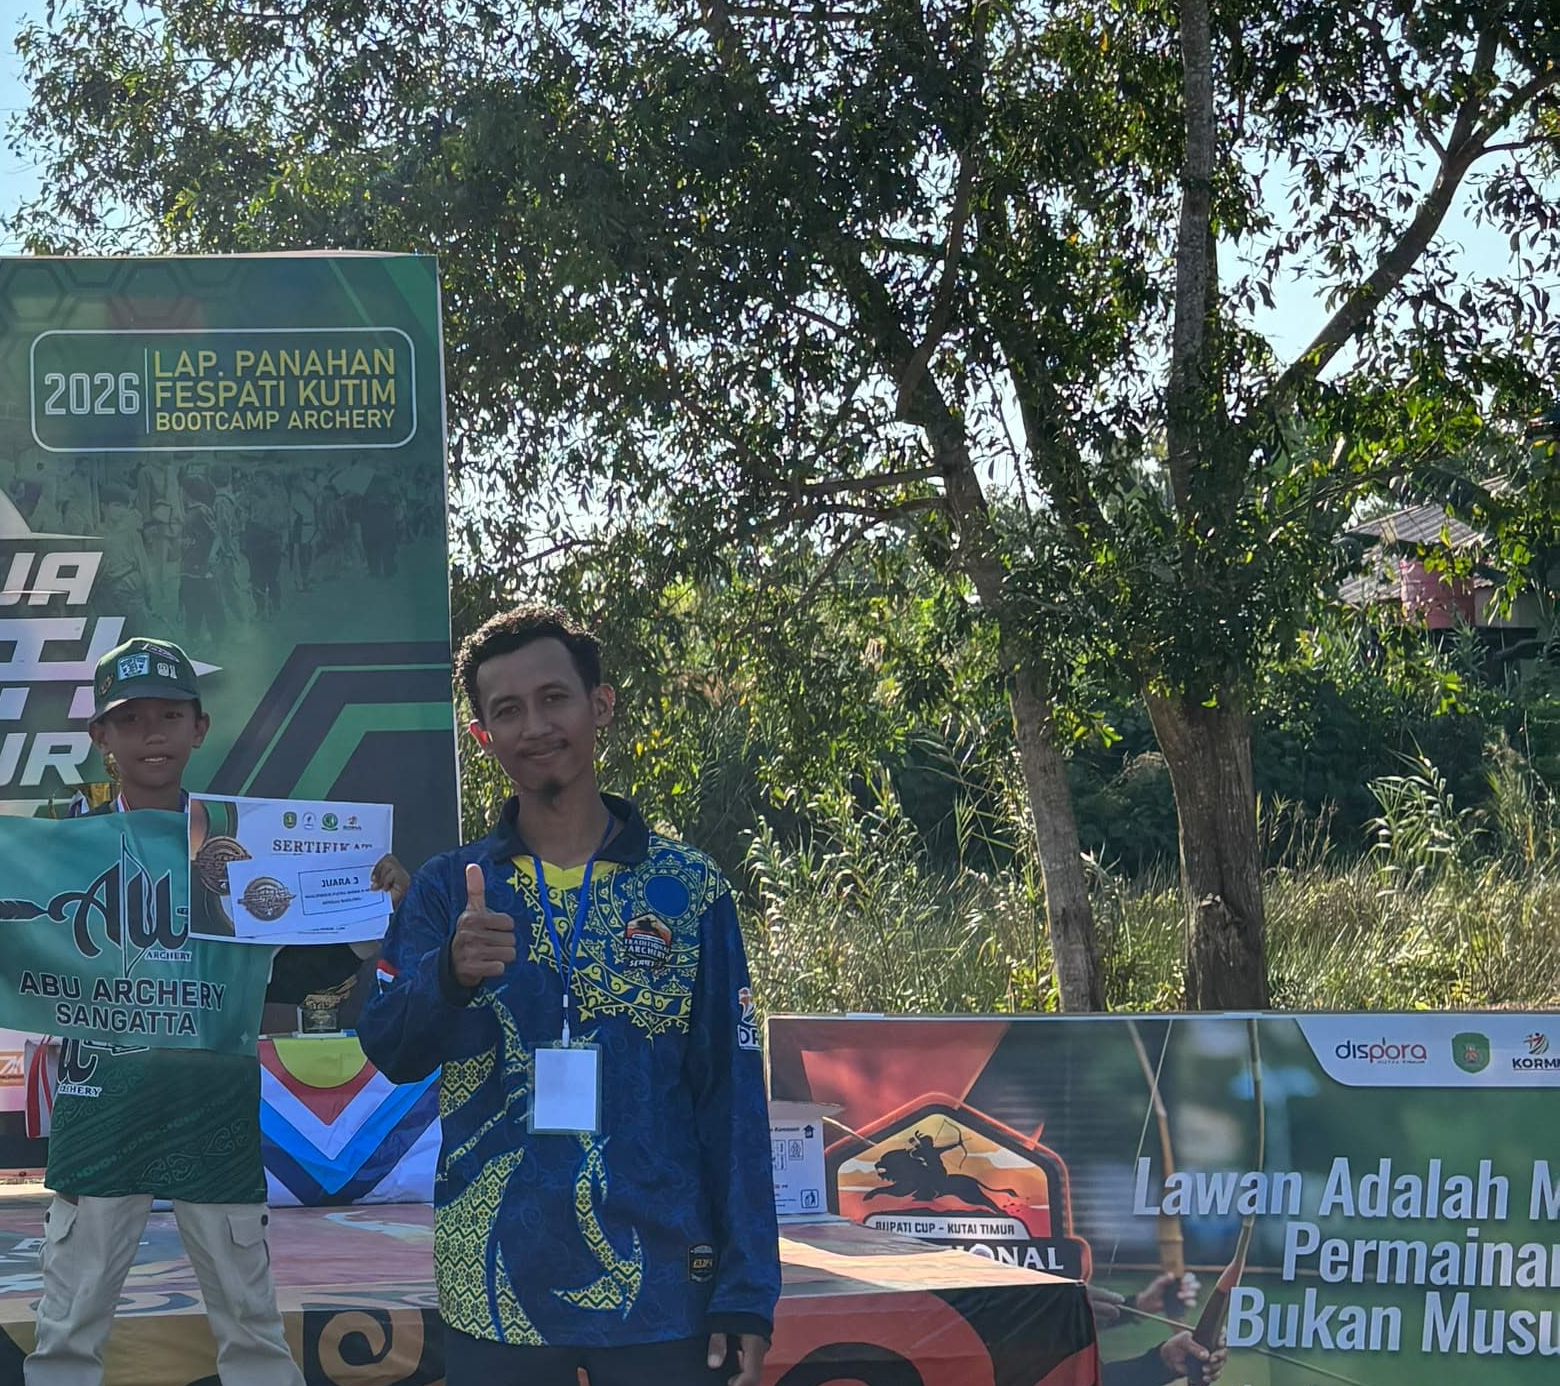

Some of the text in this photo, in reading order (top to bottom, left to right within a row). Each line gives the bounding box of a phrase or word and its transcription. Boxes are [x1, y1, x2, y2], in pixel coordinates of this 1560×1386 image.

[153, 348, 396, 378] LAP. PANAHAN
[43, 372, 141, 415] 2026
[154, 378, 397, 408] FESPATI KUTIM
[155, 410, 397, 431] BOOTCAMP ARCHERY
[322, 878, 351, 888] JUARA
[145, 950, 193, 962] ARCHERY
[19, 970, 226, 1011] ABU ARCHERY
[55, 1003, 198, 1036] SANGATTA
[1335, 1037, 1427, 1063] dispora
[1132, 1157, 1304, 1216] Lawan
[1319, 1157, 1509, 1220] Adalah
[875, 1221, 912, 1233] BUPATI
[915, 1222, 935, 1233] CUP
[947, 1223, 977, 1234] KUTAI
[981, 1224, 1015, 1235] TIMUR
[1226, 1287, 1402, 1352] Bukan
